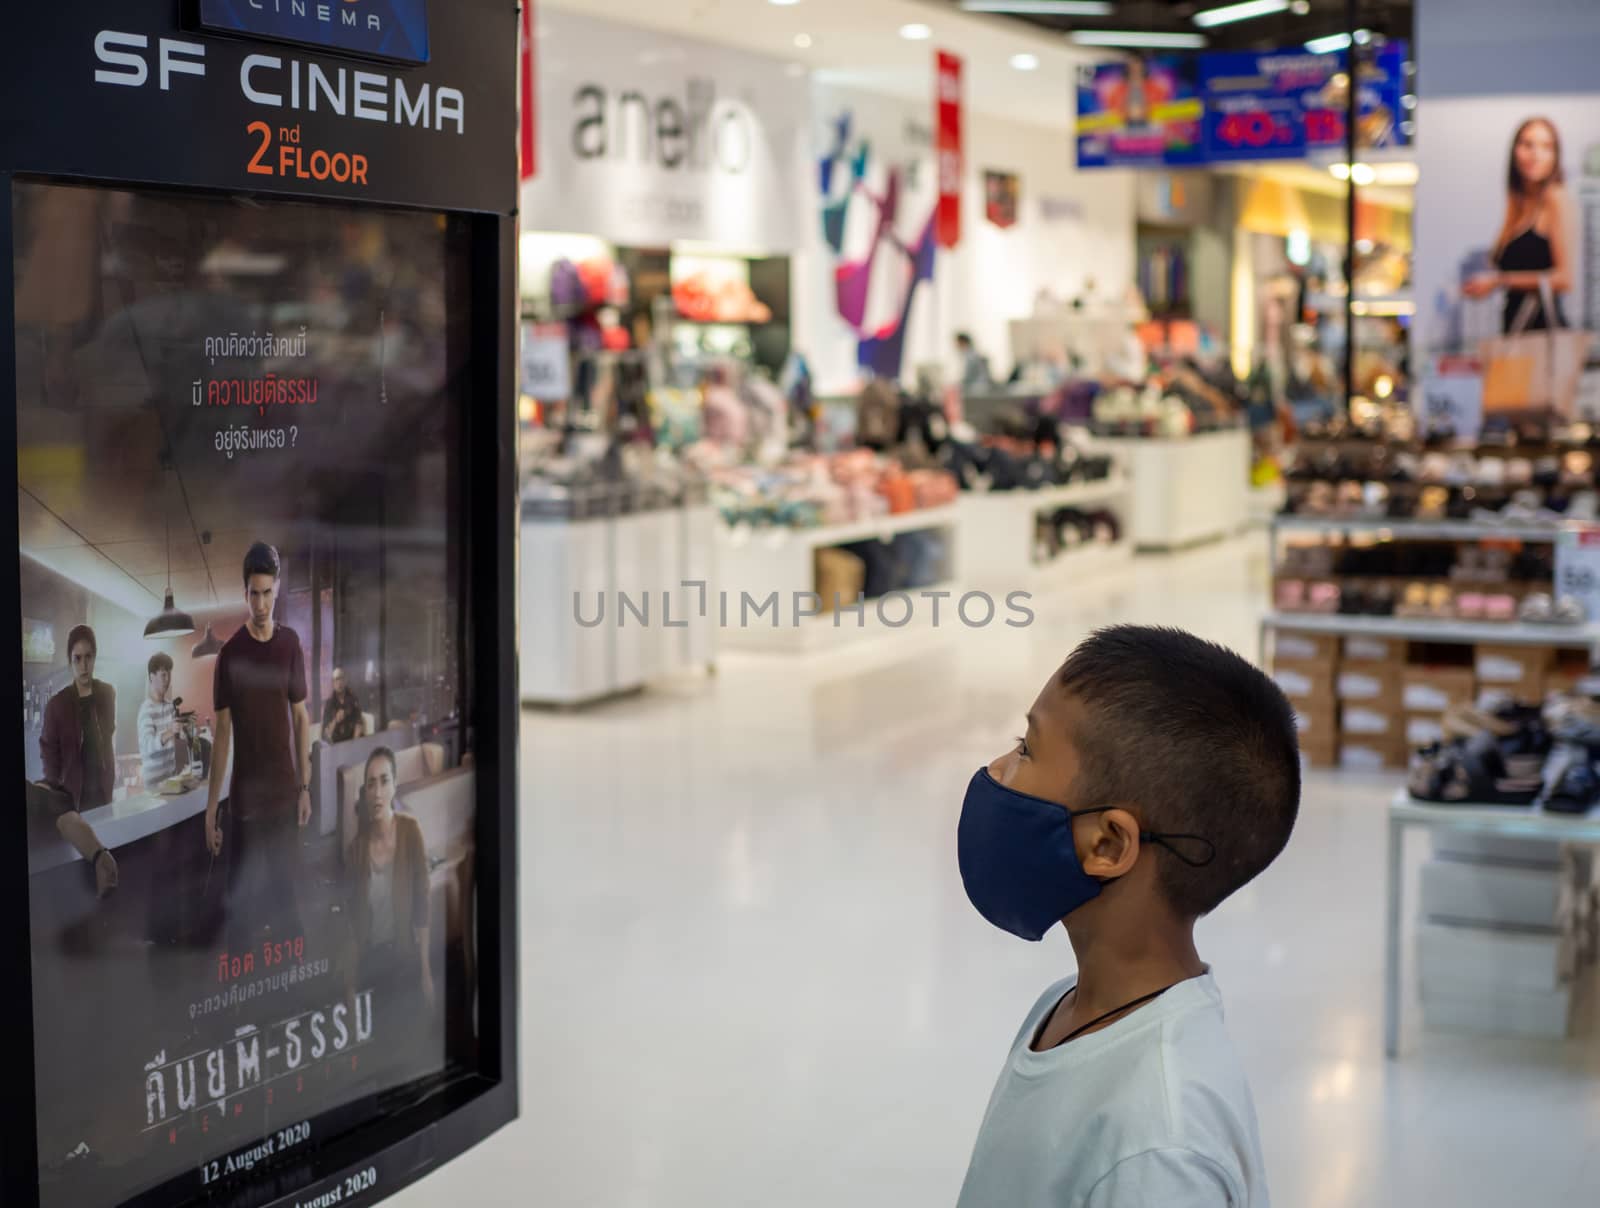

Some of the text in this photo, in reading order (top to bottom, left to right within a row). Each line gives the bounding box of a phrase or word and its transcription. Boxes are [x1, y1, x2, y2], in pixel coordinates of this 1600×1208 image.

[94, 30, 464, 134] SF CINEMA
[279, 145, 369, 185] FLOOR
[205, 326, 307, 366] คุณคิดว่าสังคมนี้
[207, 373, 319, 416] ความยุติธรรม
[203, 1120, 311, 1185] 12 August 2020
[344, 1166, 377, 1198] 2020
